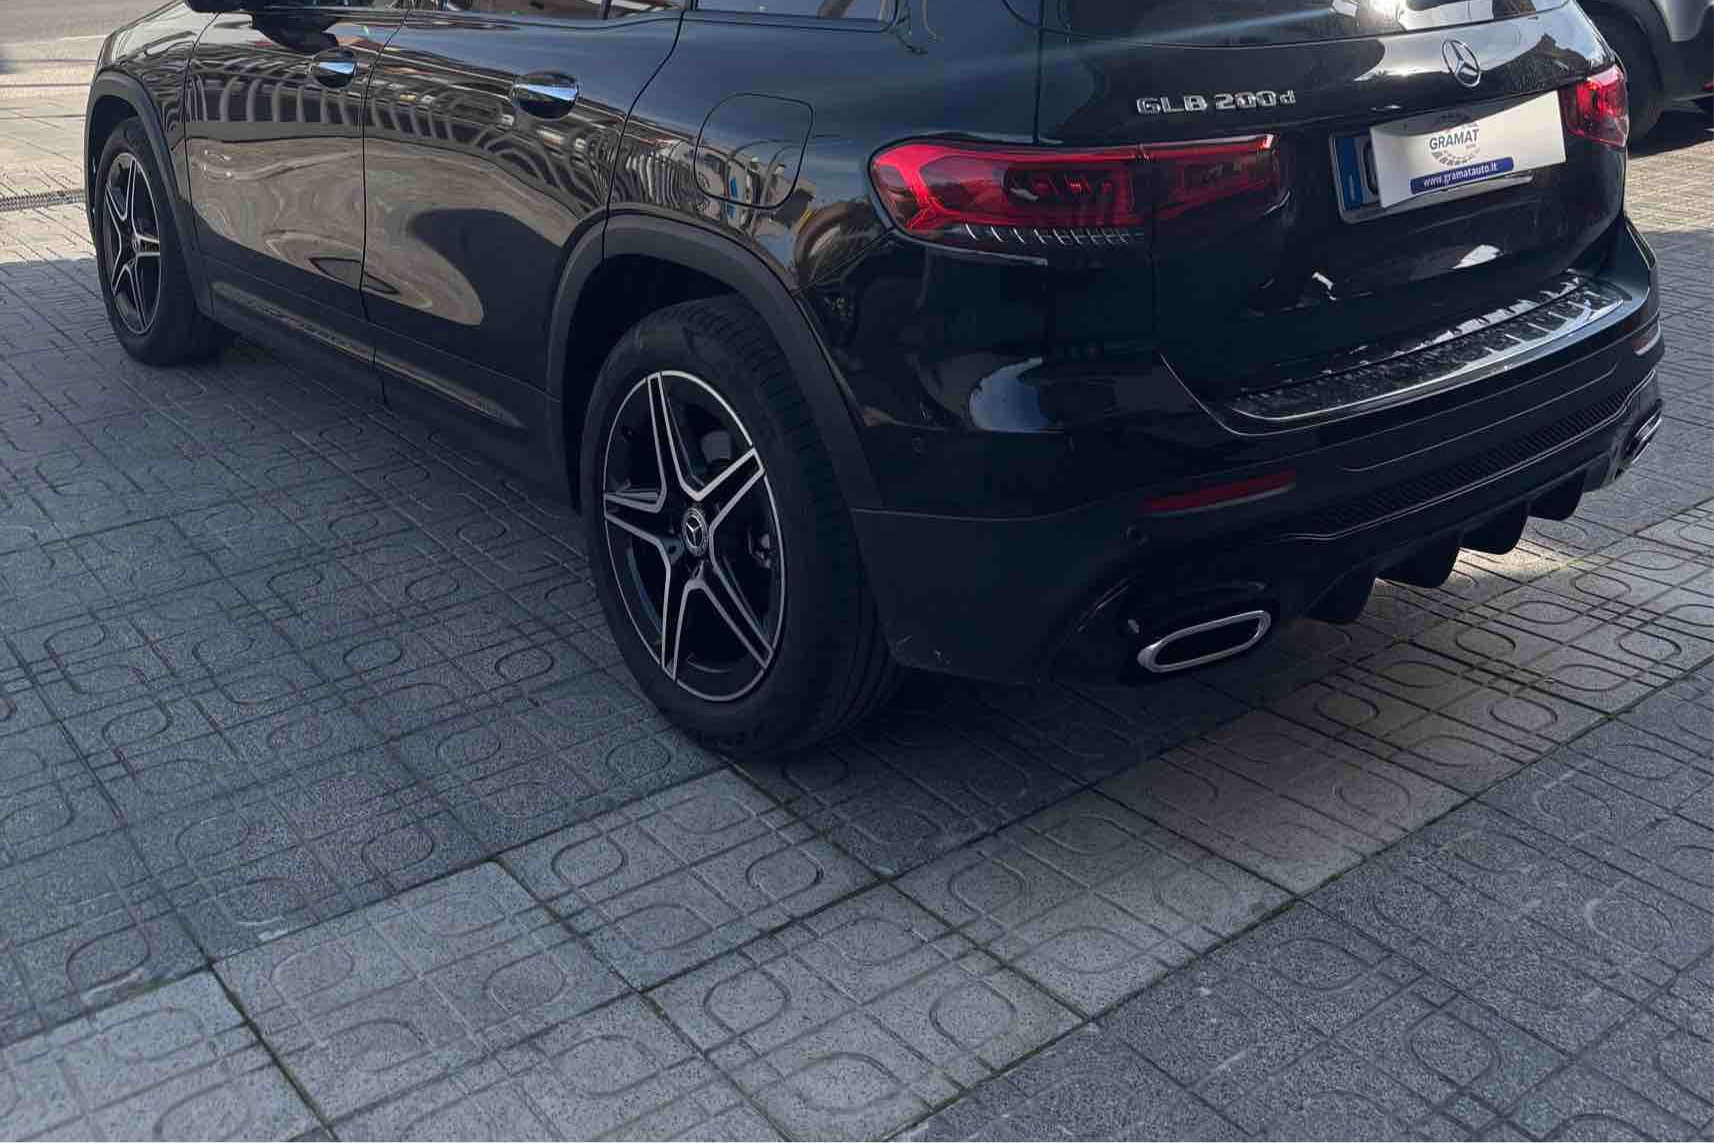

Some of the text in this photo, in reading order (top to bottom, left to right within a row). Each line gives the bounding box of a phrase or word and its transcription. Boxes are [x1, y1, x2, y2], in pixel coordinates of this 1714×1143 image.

[1136, 96, 1208, 114] GLB
[1429, 128, 1481, 151] GRAMAT
[1423, 161, 1498, 187] www.gramatauto.it
